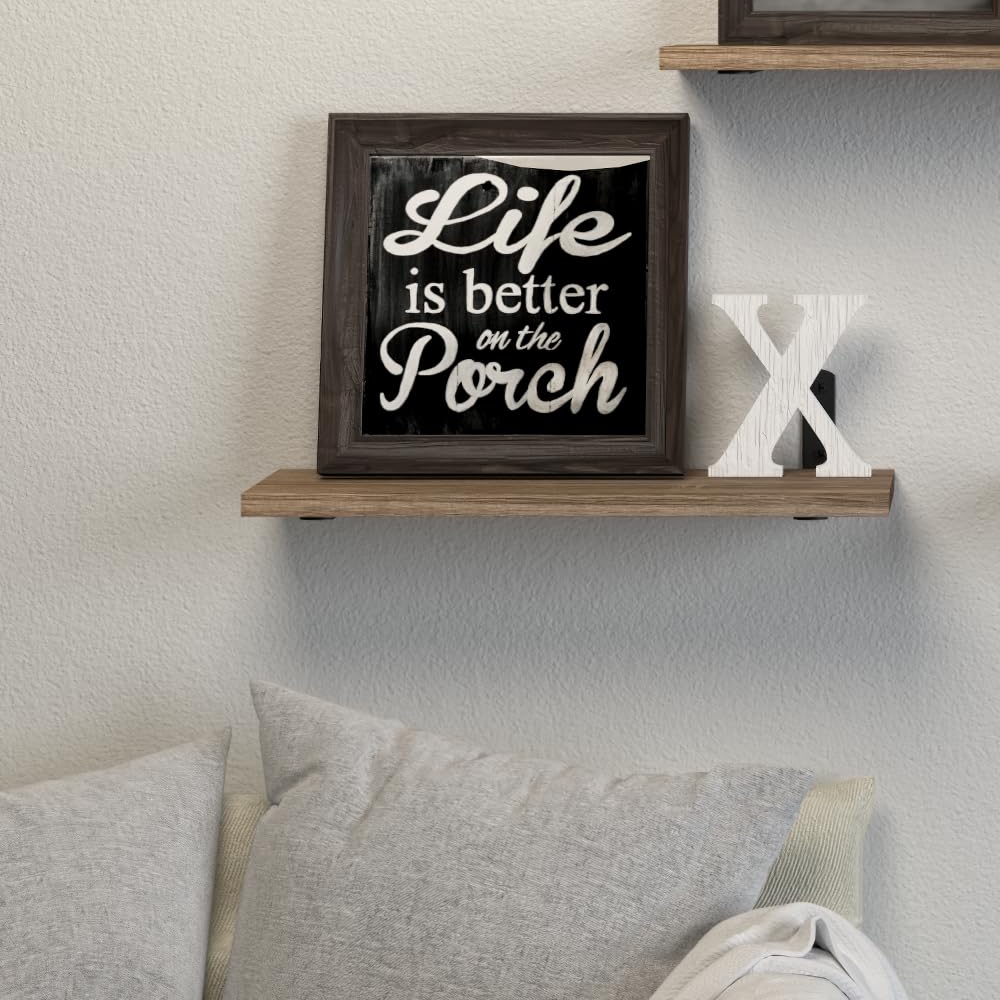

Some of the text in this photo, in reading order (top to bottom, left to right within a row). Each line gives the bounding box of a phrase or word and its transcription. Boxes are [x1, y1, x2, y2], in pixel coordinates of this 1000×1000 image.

[383, 172, 633, 275] Life
[404, 266, 610, 315] is better
[476, 321, 562, 351] on the
[379, 321, 628, 415] Porch
[707, 293, 873, 478] X
